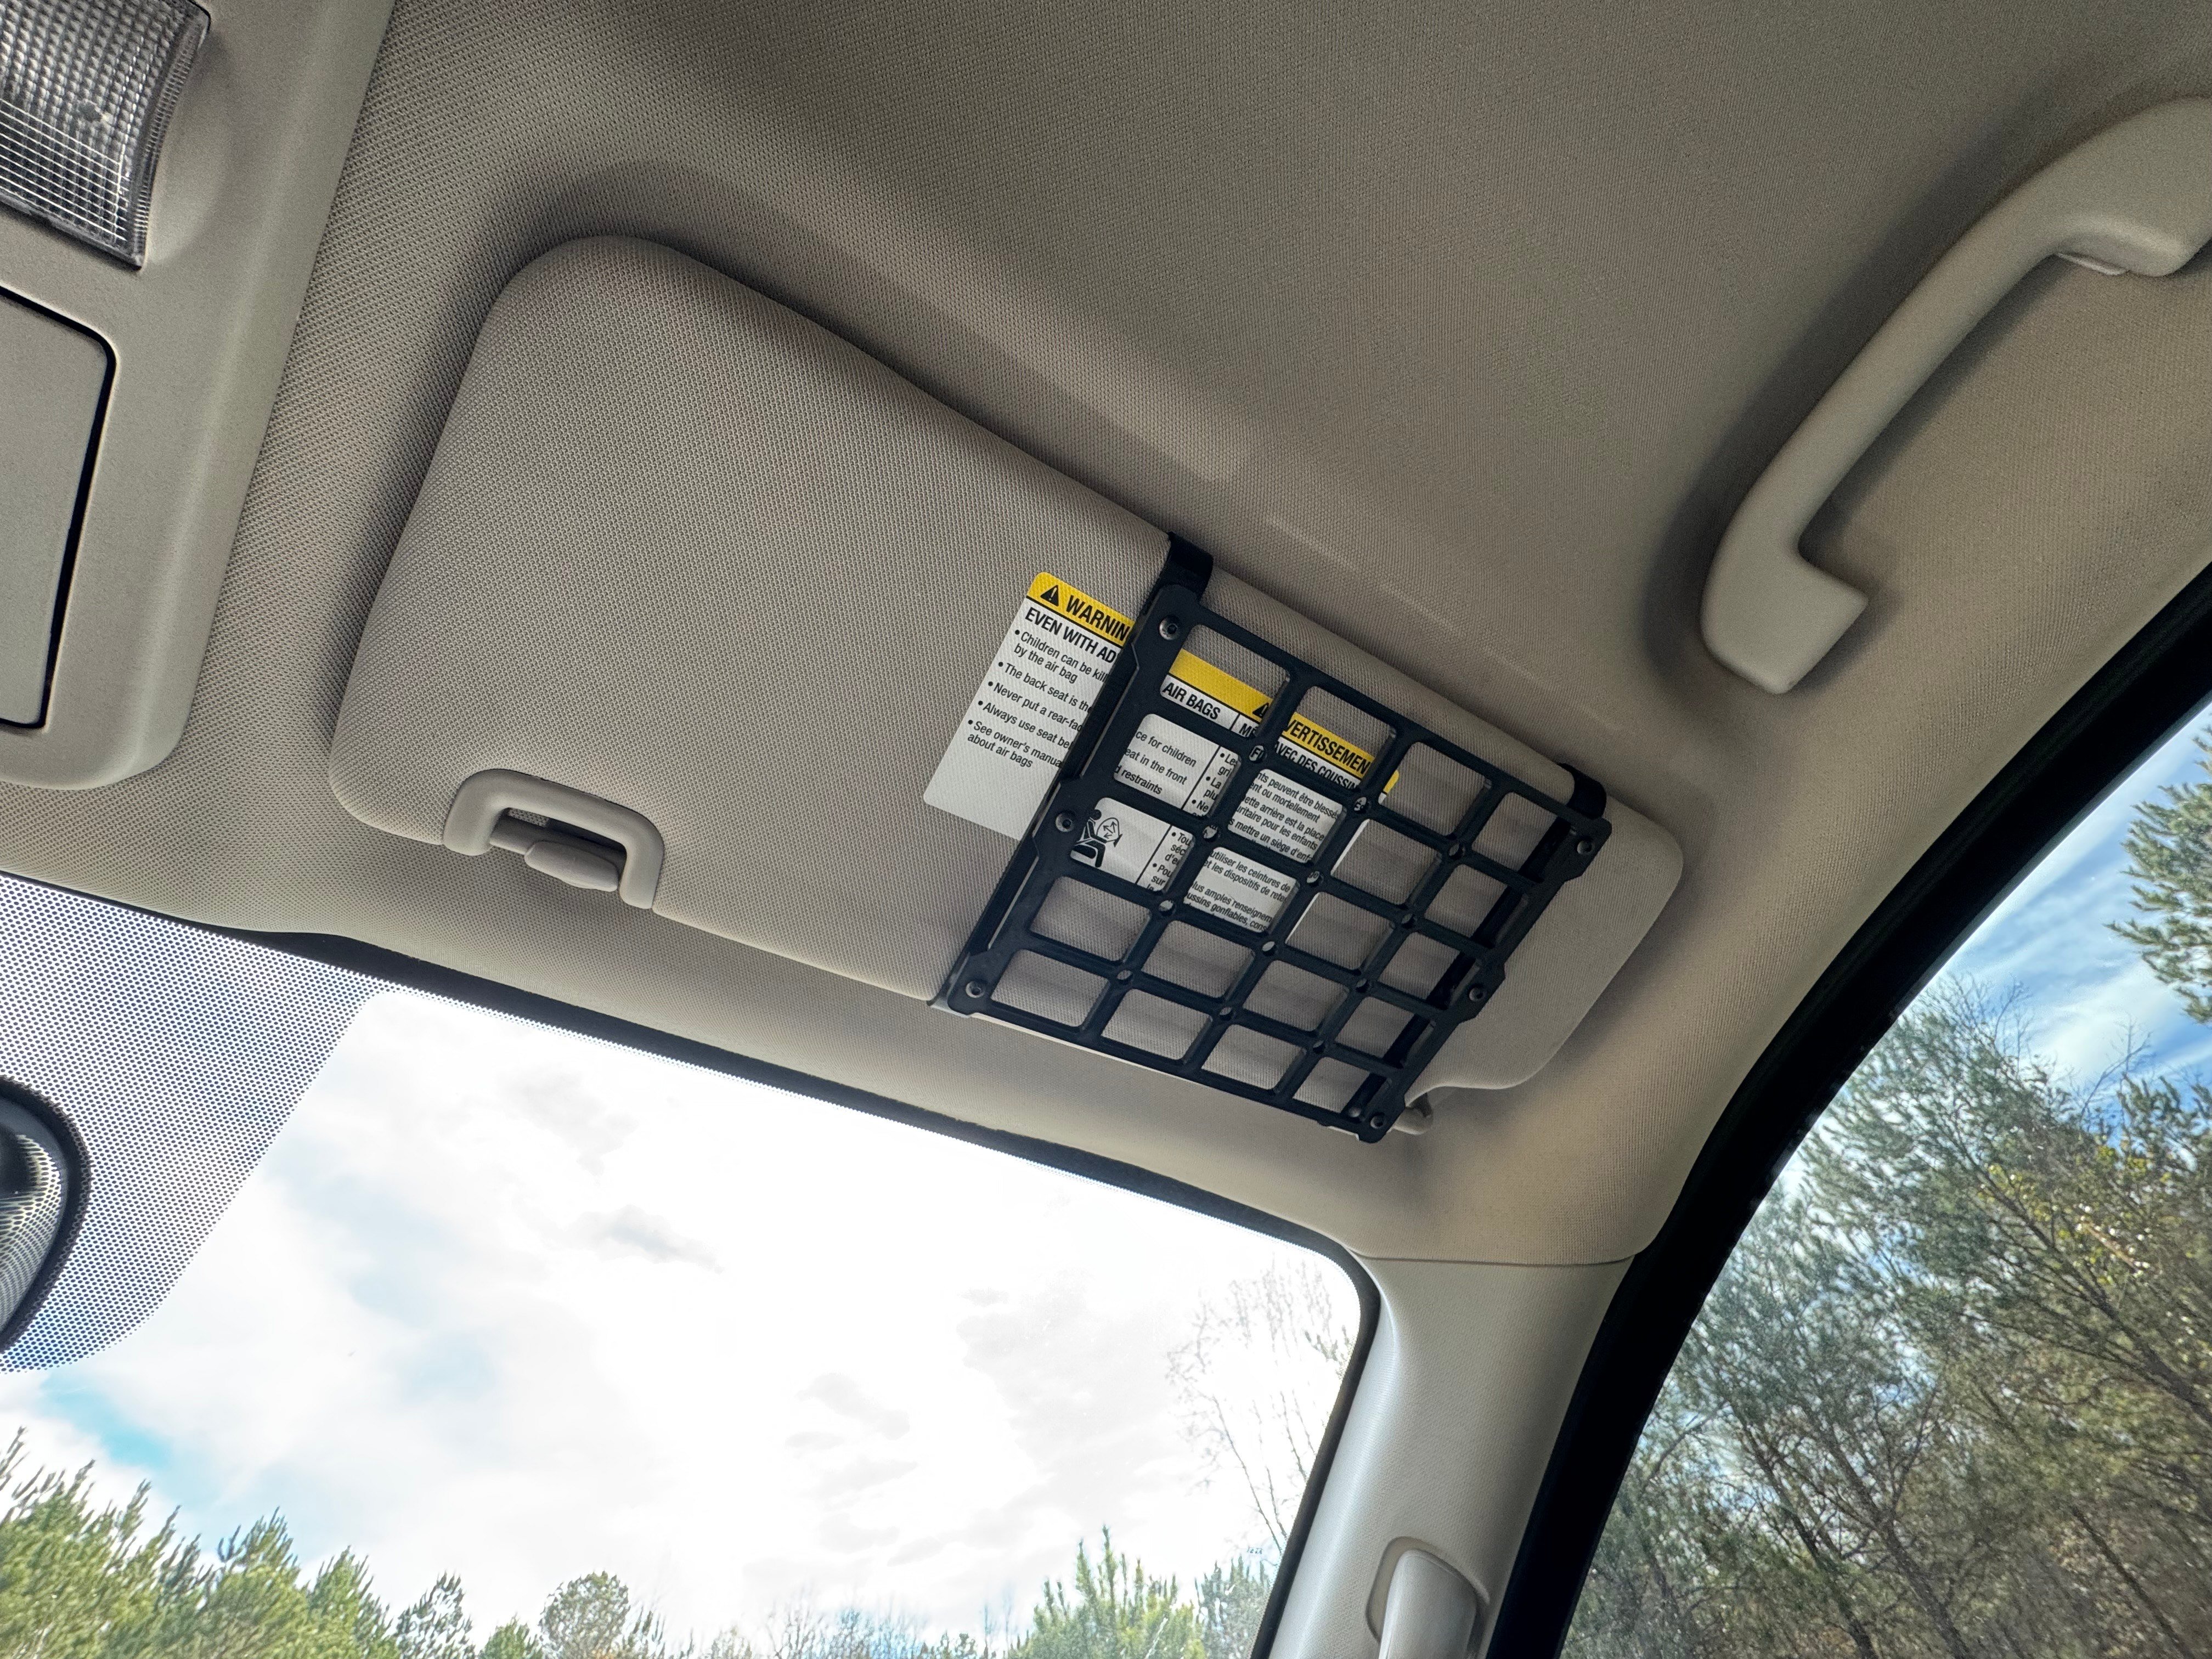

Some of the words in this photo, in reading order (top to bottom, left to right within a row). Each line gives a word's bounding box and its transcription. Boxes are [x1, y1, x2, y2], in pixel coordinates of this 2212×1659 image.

[1066, 595, 1130, 641] WARNIN
[1014, 642, 1028, 658] by
[1028, 650, 1044, 665] the
[1045, 660, 1060, 673] air
[1059, 665, 1078, 684] bag
[1021, 631, 1060, 658] Children
[1060, 654, 1079, 668] can
[1079, 662, 1092, 675] be
[1092, 668, 1108, 682] kill
[1025, 607, 1063, 635] EVEN
[1063, 626, 1099, 654] WITH
[1096, 646, 1117, 663] AD
[1162, 682, 1187, 703] AIR
[1186, 693, 1221, 720] BAGS
[993, 682, 1023, 703] Never
[1022, 698, 1040, 712] put
[1040, 707, 1047, 715] a
[1047, 710, 1083, 732] rear-fac
[1125, 748, 1140, 761] eat
[1139, 754, 1150, 766] in
[1150, 760, 1165, 774] the
[1165, 768, 1187, 786] front
[1005, 663, 1023, 679] The
[1023, 673, 1048, 692] back
[1047, 686, 1069, 702] seat
[1068, 695, 1078, 707] is
[1135, 731, 1147, 741] ce
[1148, 736, 1163, 749] for
[1161, 745, 1197, 768] children
[967, 733, 996, 751] about
[995, 746, 1010, 757] air
[1009, 751, 1034, 768] bags
[973, 721, 992, 736] See
[993, 731, 1030, 753] owner's
[1030, 748, 1062, 768] manua
[983, 702, 1018, 724] Always
[1018, 720, 1036, 733] use
[1036, 728, 1058, 743] seat
[1058, 736, 1071, 749] be
[1121, 769, 1163, 795] restraints
[1297, 754, 1318, 772] DES
[1203, 789, 1218, 800] plu
[1237, 806, 1262, 822] uritaire
[1260, 818, 1280, 831] pour
[1279, 825, 1291, 838] les
[1291, 833, 1318, 850] enfants
[1210, 777, 1222, 789] La
[1244, 796, 1260, 809] ette
[1260, 804, 1285, 821] arrière
[1284, 817, 1298, 828] est
[1296, 821, 1305, 832] la
[1304, 828, 1325, 841] place
[1258, 772, 1269, 783] nts
[1267, 778, 1300, 799] peuvent
[1299, 793, 1314, 806] être
[1313, 800, 1338, 819] blessé
[1261, 788, 1273, 798] ou
[1272, 794, 1321, 823] mortellement
[1197, 800, 1209, 812] Ne
[1235, 821, 1260, 838] mettre
[1260, 833, 1271, 843] un
[1271, 838, 1291, 852] siège
[1290, 847, 1312, 861] d'enf
[1177, 832, 1192, 846] Tou
[1235, 861, 1248, 873] les
[1248, 868, 1281, 888] ceintures
[1280, 883, 1290, 893] de
[1211, 862, 1224, 874] les
[1223, 869, 1261, 891] dispositifs
[1260, 886, 1270, 895] de
[1150, 876, 1166, 885] sur
[1186, 892, 1211, 908] ussins
[1156, 864, 1172, 877] Pou
[1192, 881, 1205, 893] lus
[1204, 888, 1232, 905] amples
[1231, 899, 1273, 922] renseignem
